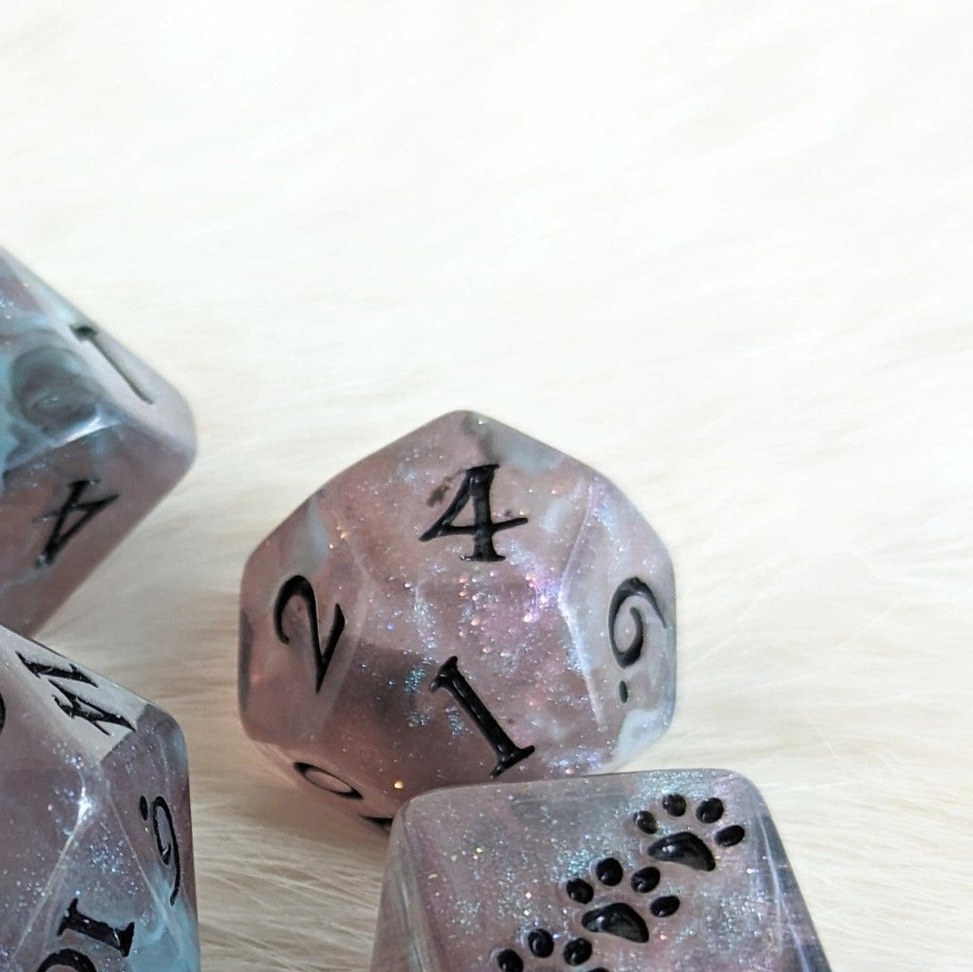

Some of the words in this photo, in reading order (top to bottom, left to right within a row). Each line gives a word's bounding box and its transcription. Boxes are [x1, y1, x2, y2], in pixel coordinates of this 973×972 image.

[33, 478, 119, 570] 4
[417, 463, 529, 562] 4
[273, 574, 346, 694] 2
[427, 655, 536, 780] 1
